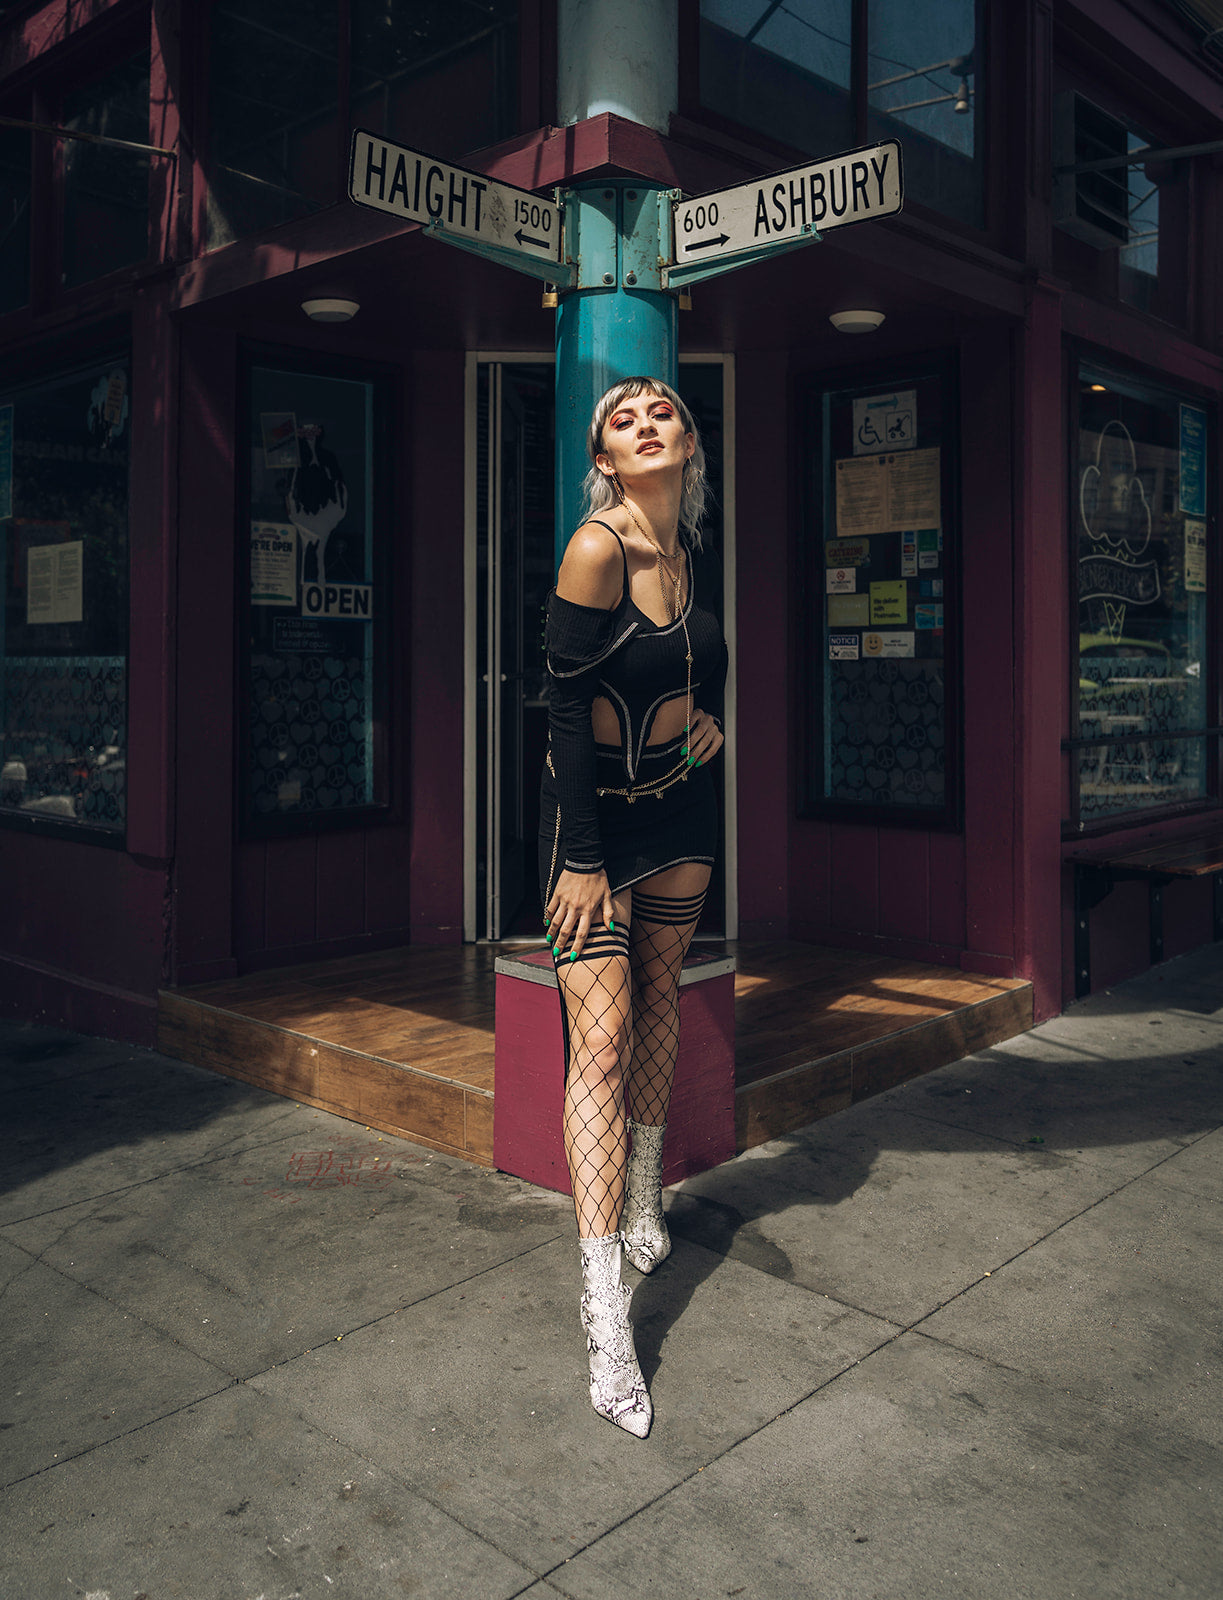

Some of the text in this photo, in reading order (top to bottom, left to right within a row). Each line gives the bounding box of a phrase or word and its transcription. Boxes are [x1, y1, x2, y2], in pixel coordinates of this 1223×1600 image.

[365, 141, 487, 232] HAIGHT
[753, 153, 890, 237] ASHBURY
[514, 199, 552, 233] 1500
[683, 205, 719, 233] 600
[251, 540, 293, 553] E'RE OPEN
[306, 586, 369, 615] OPEN
[830, 637, 856, 645] NOTICE
